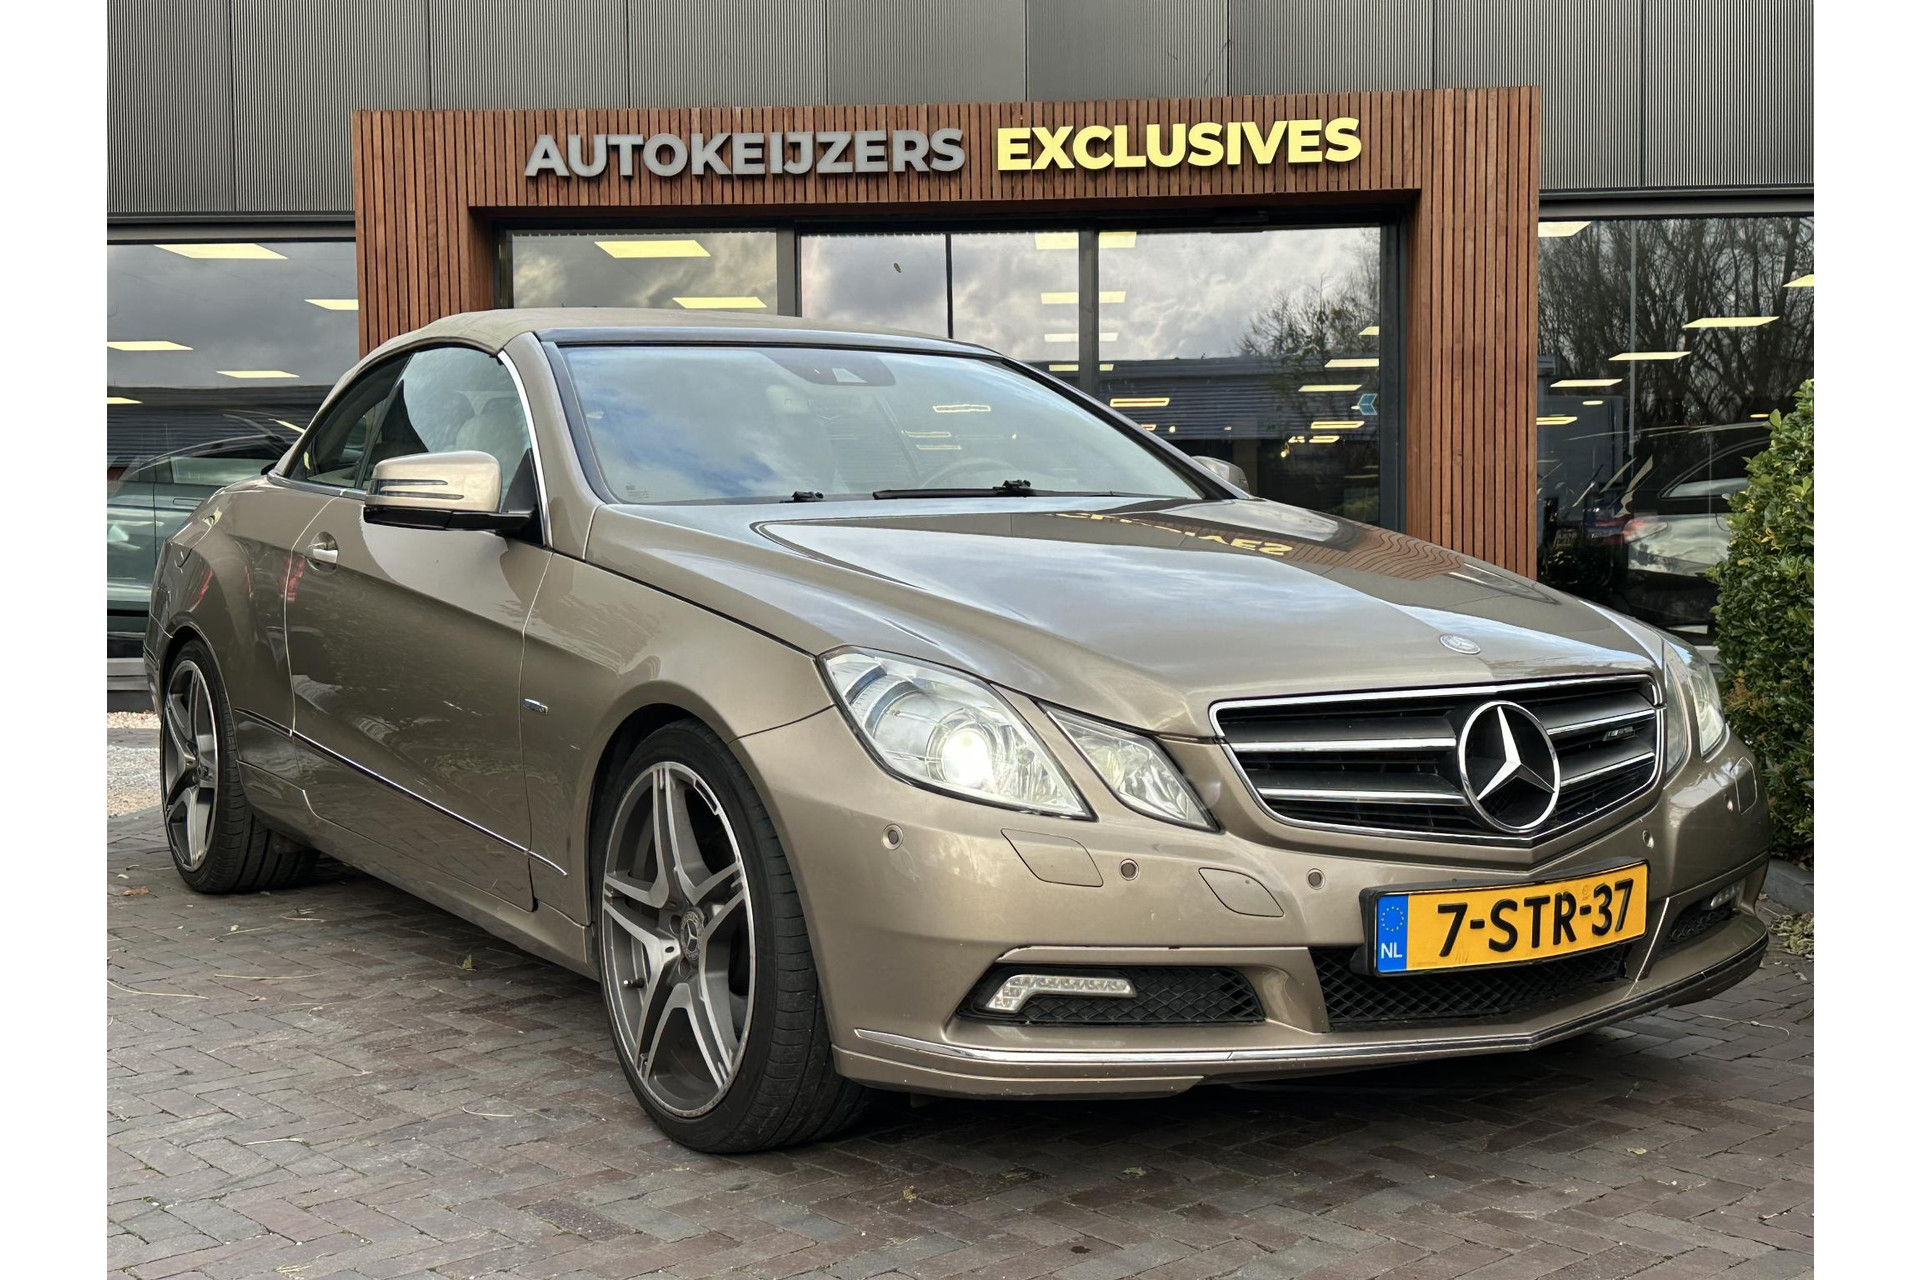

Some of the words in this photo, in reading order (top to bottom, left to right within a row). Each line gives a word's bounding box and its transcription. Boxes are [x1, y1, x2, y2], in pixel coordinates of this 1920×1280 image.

[524, 128, 967, 177] AUTOKEIJZERS
[997, 117, 1362, 171] EXCLUSIVES
[1437, 878, 1634, 957] 7-STR-37
[1380, 942, 1403, 959] NL
